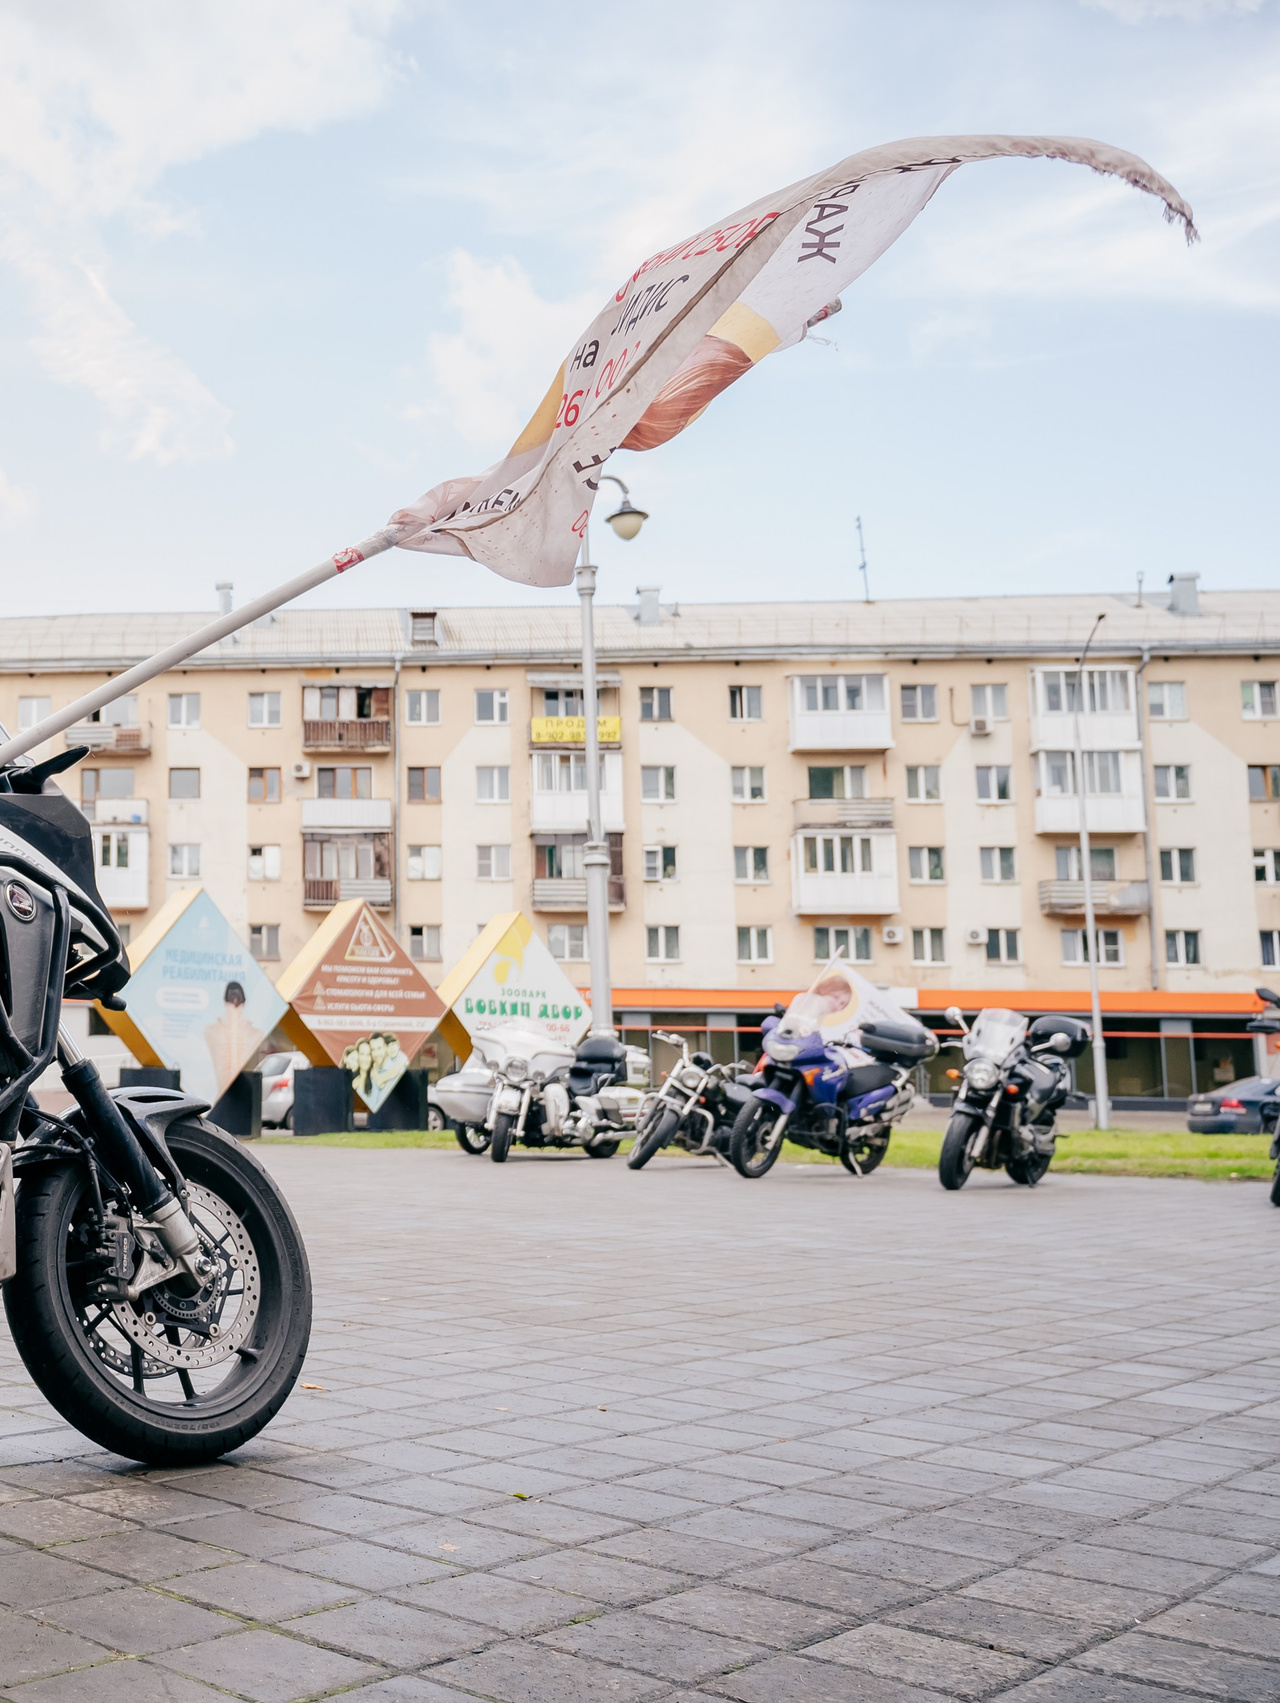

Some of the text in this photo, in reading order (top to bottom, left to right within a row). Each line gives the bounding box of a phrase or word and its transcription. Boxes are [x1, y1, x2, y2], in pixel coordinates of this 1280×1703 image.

[570, 340, 600, 372] на
[545, 719, 607, 729] ПРОДМ
[165, 948, 242, 967] МЕДИЦИНСКАЯ
[162, 965, 246, 983] РЕАБИЛИТАЦИЯ
[326, 988, 373, 998] СТОМАТОЛОГИЯ
[501, 988, 547, 999] ЗООПАРК
[538, 1004, 582, 1020] ДВОР
